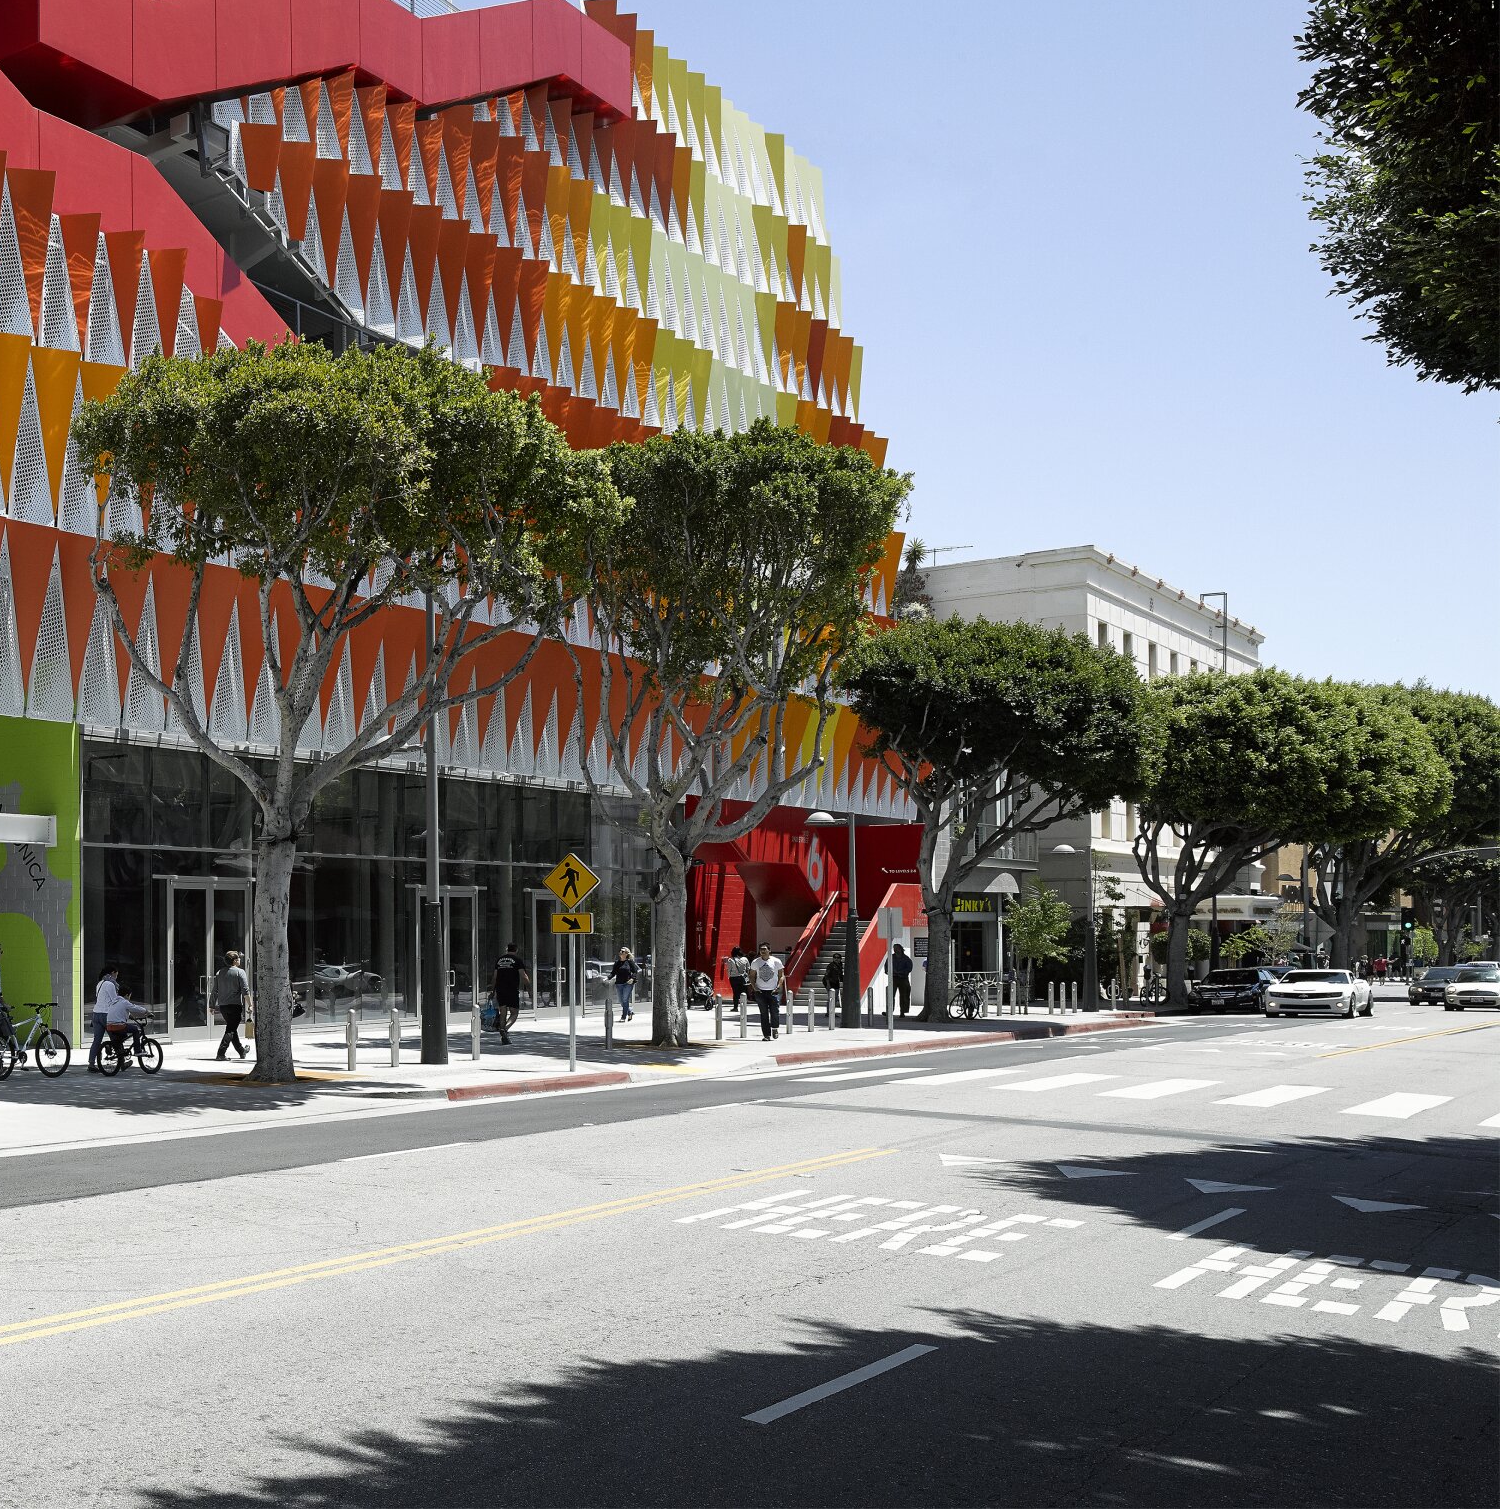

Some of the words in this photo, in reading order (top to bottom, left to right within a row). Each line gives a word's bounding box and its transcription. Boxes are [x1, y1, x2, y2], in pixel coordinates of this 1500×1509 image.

[13, 842, 46, 891] NICA
[807, 832, 824, 892] 6
[954, 897, 992, 912] JINKY'S
[672, 1189, 1088, 1263] HERE
[1151, 1242, 1500, 1339] HER
